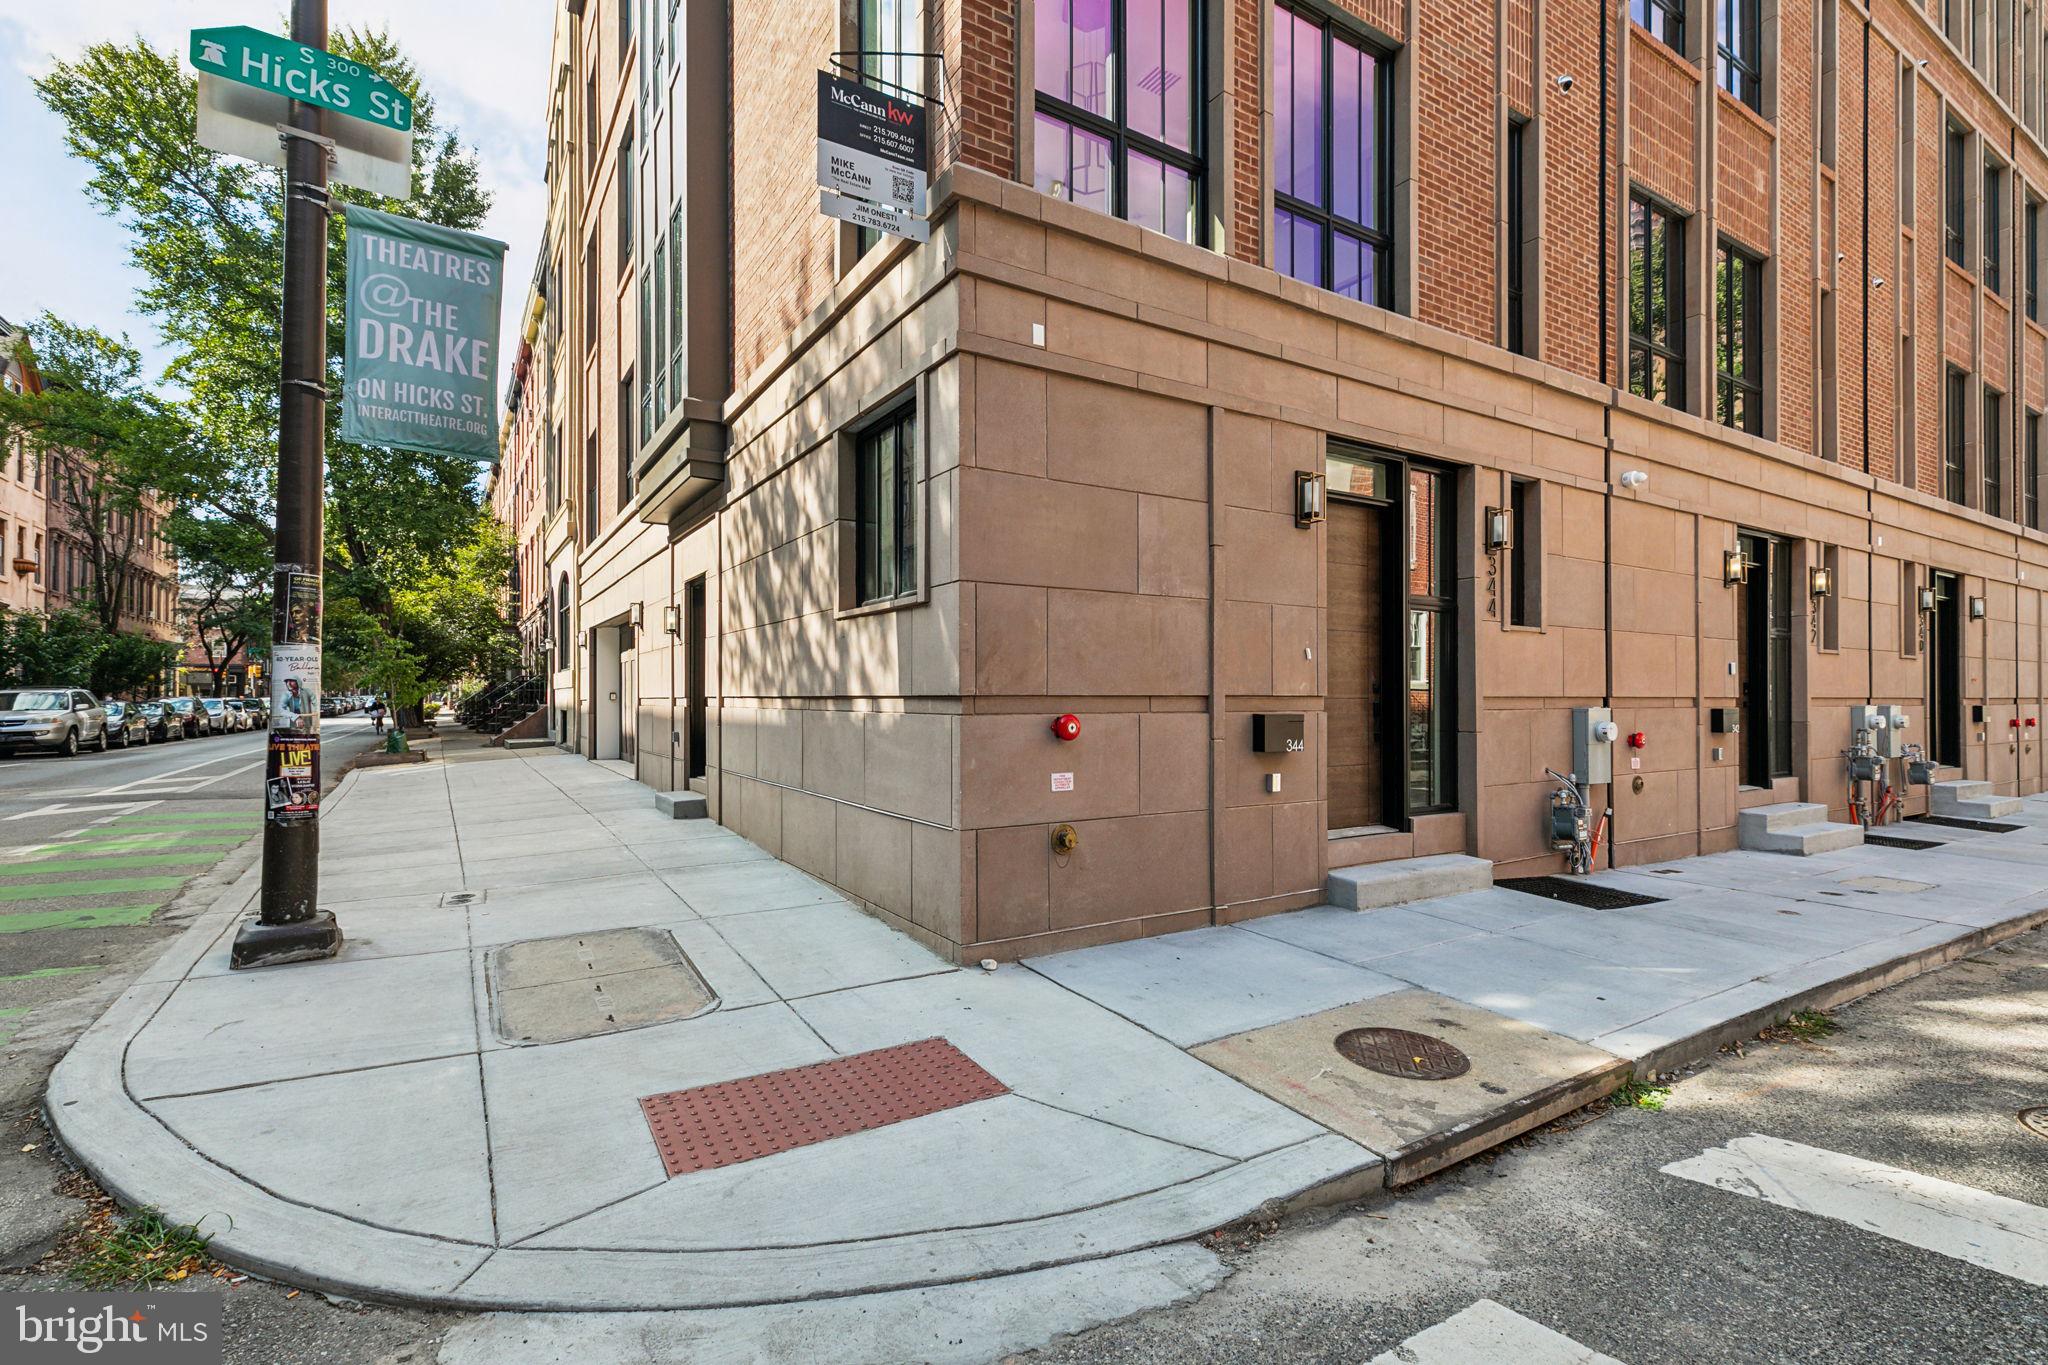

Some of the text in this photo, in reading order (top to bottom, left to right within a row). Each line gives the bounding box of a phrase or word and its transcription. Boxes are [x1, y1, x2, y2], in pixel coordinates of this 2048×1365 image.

[299, 46, 360, 78] S 300
[241, 46, 404, 126] Hicks St
[831, 86, 914, 126] McCann kw
[873, 125, 915, 146] 215.709.4141
[873, 135, 915, 154] 215.607.6007
[831, 156, 856, 171] MIKE
[831, 166, 872, 186] McCANN
[852, 213, 900, 233] 215.783.6724
[856, 204, 897, 222] JIM ONESTI
[362, 234, 491, 287] THEATRES
[358, 318, 489, 381] DRAKE
[357, 378, 489, 418] ON HICKS ST.
[357, 404, 488, 436] INTERACTTHEATRE.ORG
[1487, 556, 1497, 618] 344
[1286, 738, 1304, 752] 344
